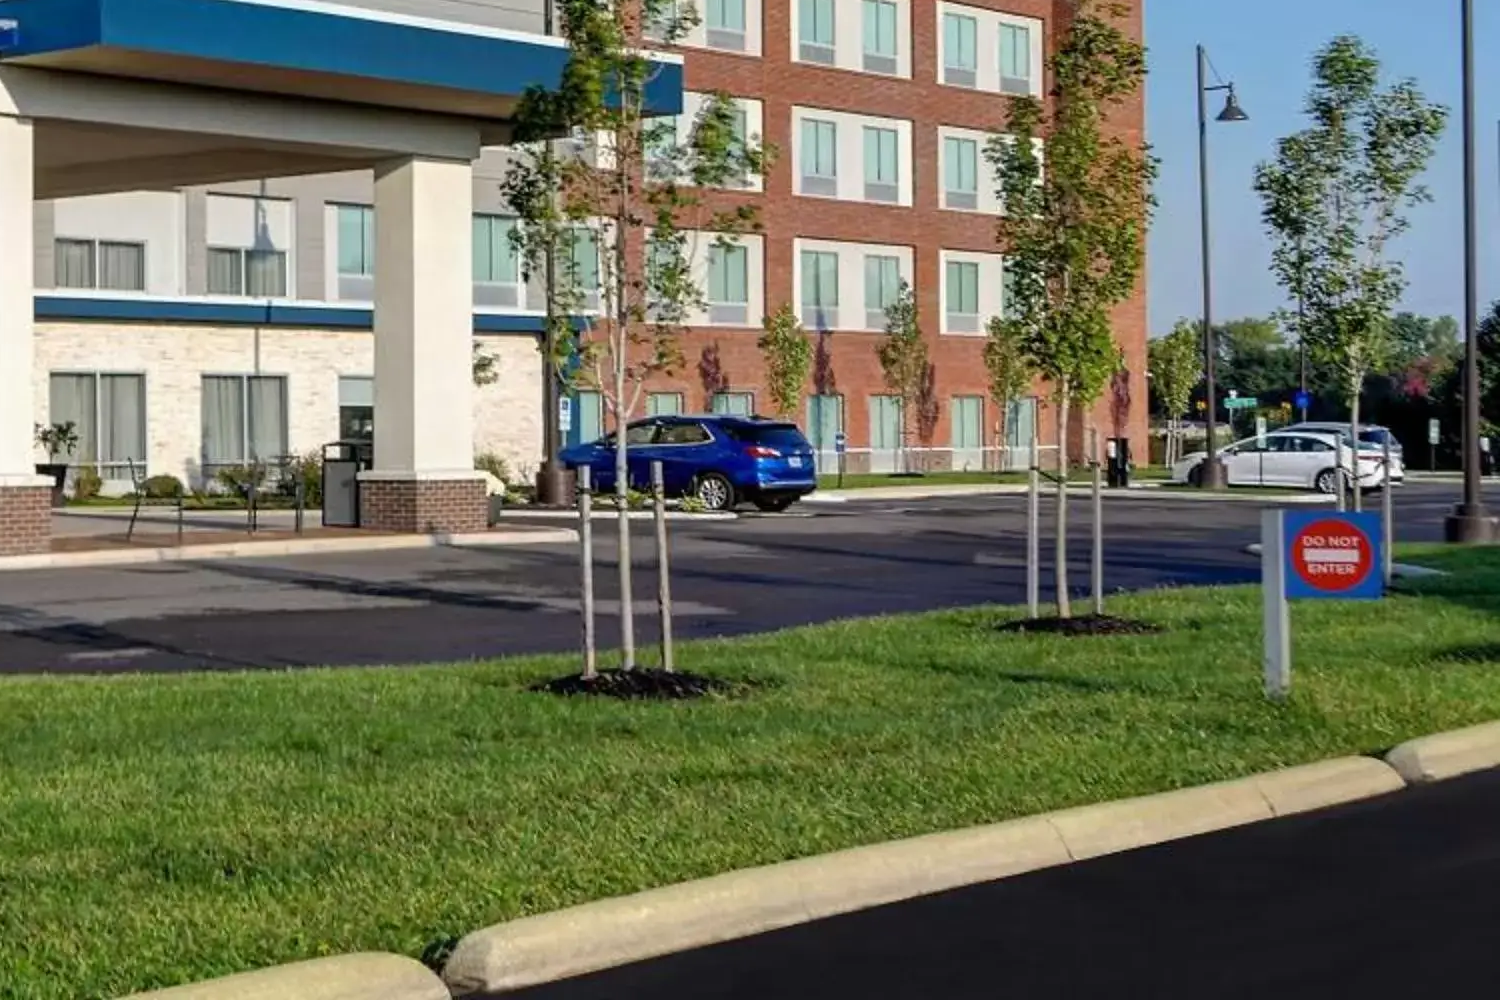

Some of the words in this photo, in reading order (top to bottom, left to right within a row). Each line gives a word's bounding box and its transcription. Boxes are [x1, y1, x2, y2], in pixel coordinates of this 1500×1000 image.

[1302, 535, 1326, 547] DO
[1328, 535, 1360, 547] NOT
[1307, 564, 1356, 575] ENTER
